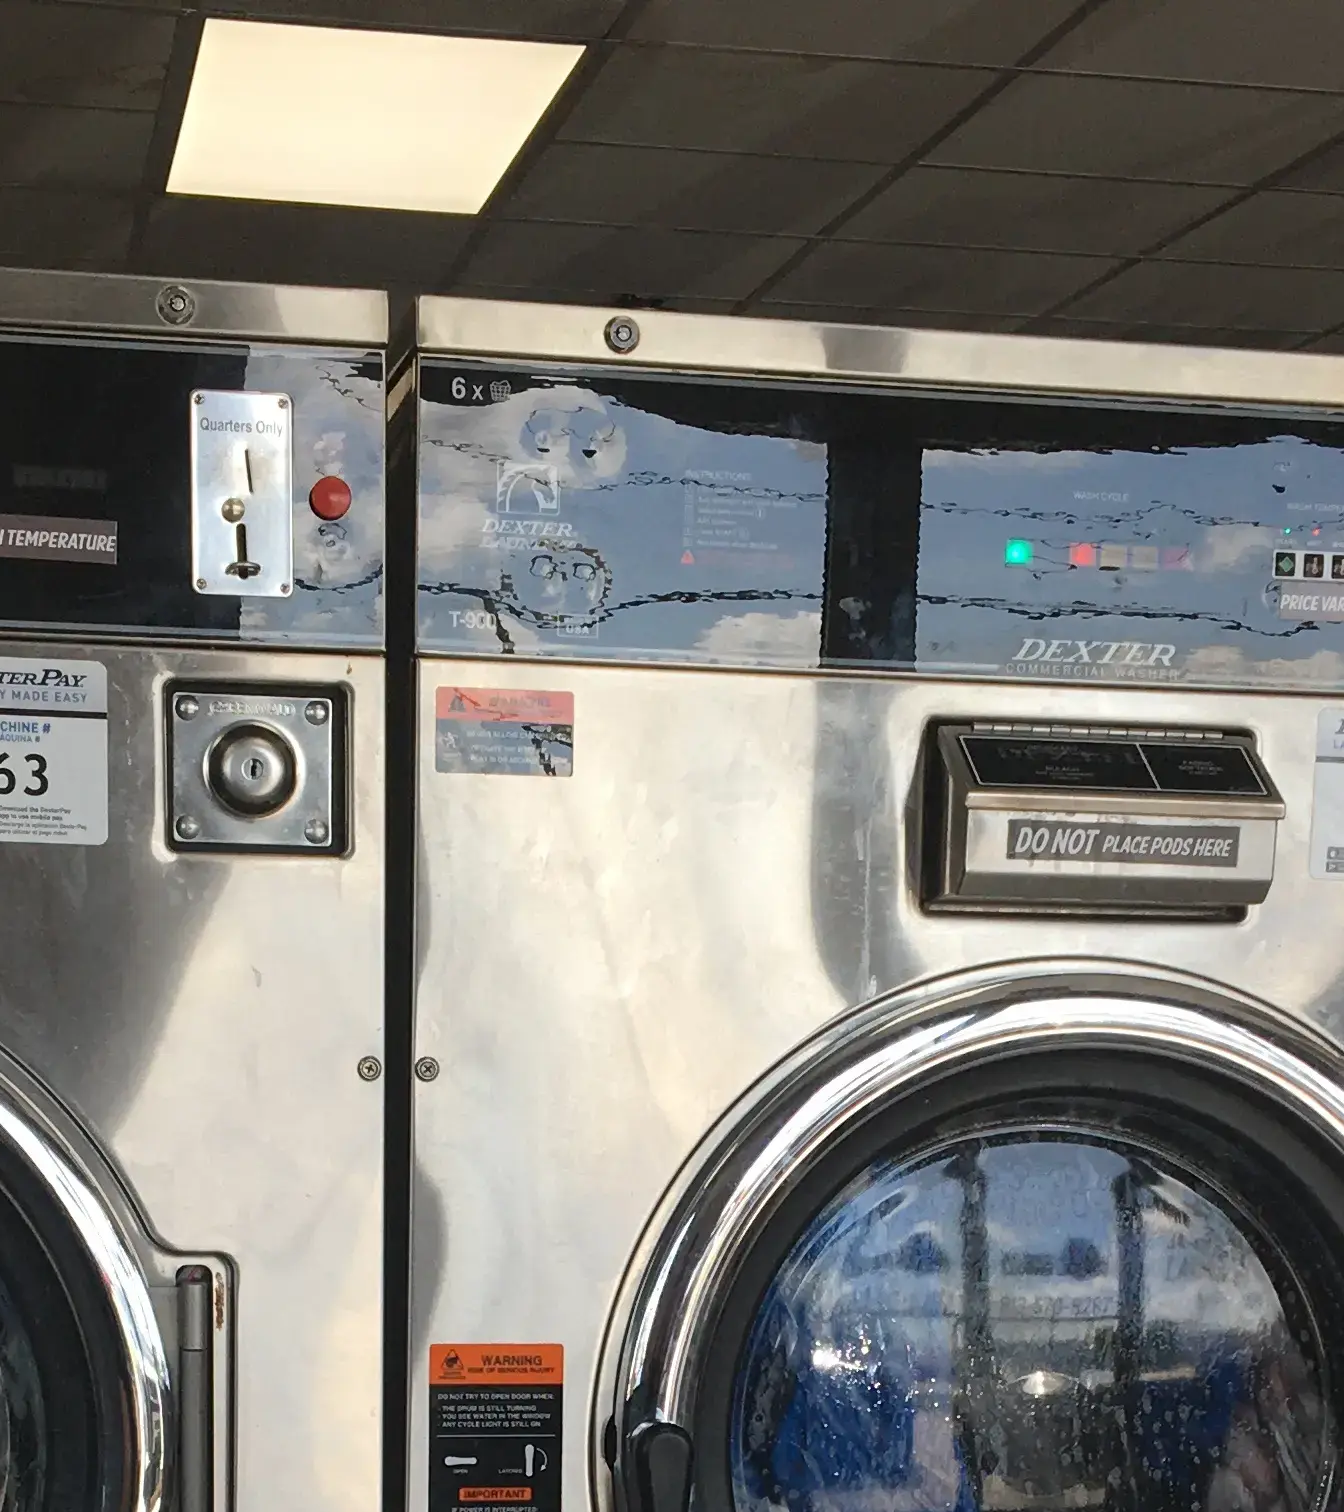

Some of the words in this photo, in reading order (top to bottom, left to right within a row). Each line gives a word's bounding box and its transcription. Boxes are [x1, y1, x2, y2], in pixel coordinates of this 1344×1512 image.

[451, 376, 466, 400] 6
[471, 384, 484, 400] x
[200, 417, 252, 433] Quarters
[256, 420, 283, 437] Only
[1073, 491, 1100, 500] WASH
[1100, 493, 1129, 502] CYCLE
[482, 518, 573, 538] DEXTER
[7, 529, 116, 552] TEMPERATURE
[1280, 594, 1317, 610] PRICE
[1012, 638, 1176, 666] DEXTER
[1006, 663, 1105, 677] COMMERCIAL
[11, 690, 48, 702] MADE
[54, 692, 88, 703] EASY
[42, 723, 51, 734] #
[1015, 826, 1049, 854] DO
[1052, 827, 1100, 855] NOT
[1102, 834, 1149, 855] PLACE
[1150, 837, 1190, 856] PODS
[1192, 838, 1233, 857] HERE
[481, 1355, 542, 1366] WARNING
[463, 1490, 526, 1498] IMPORTANT
